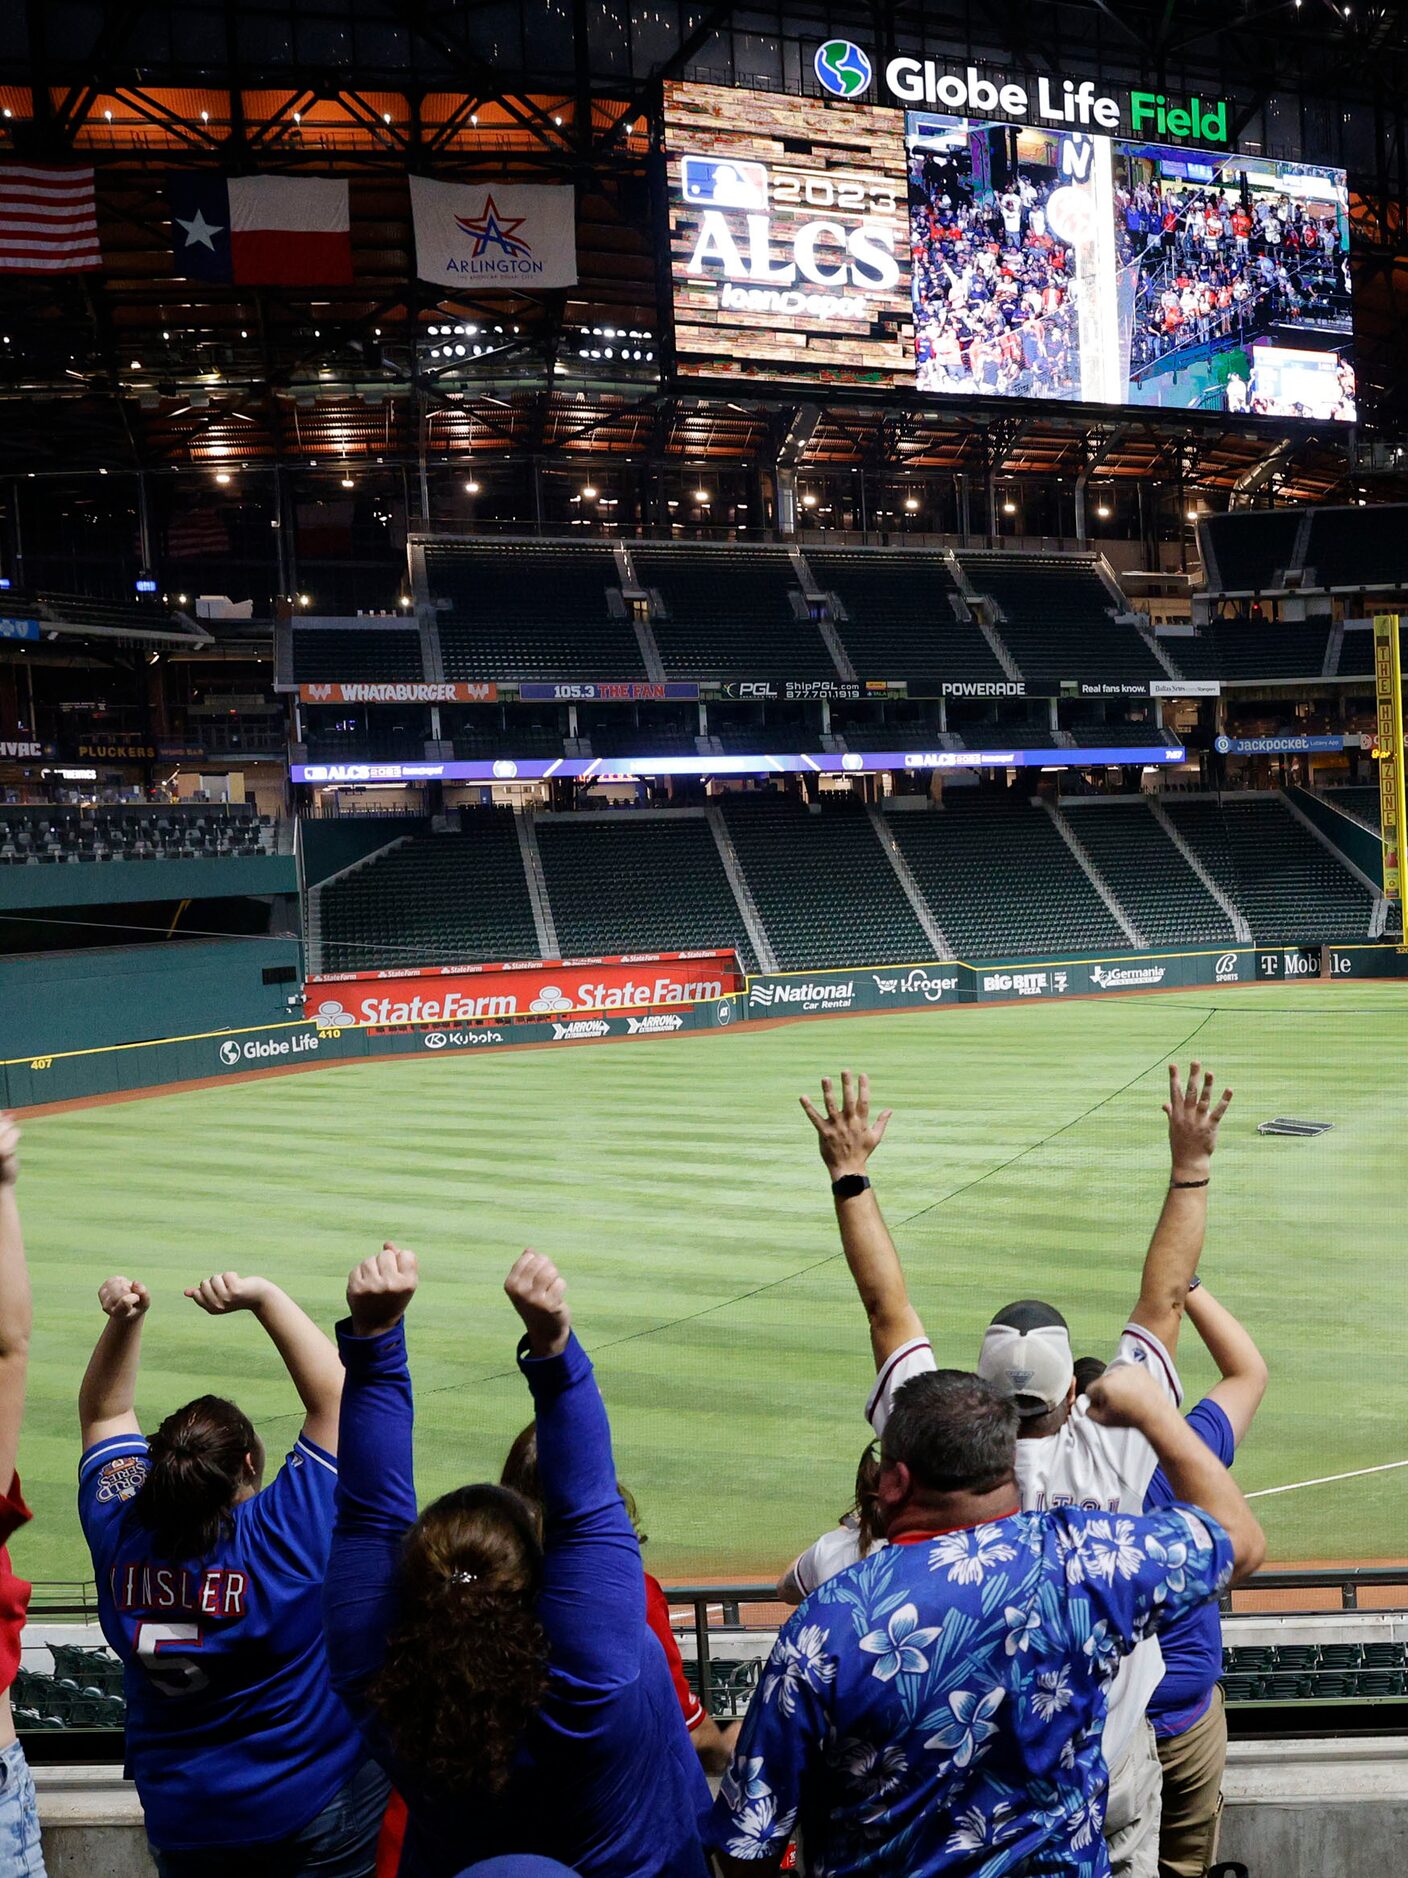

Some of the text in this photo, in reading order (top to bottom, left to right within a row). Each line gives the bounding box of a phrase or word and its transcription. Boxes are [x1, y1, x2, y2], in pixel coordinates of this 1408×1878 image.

[886, 56, 1227, 142] Globe Life Field
[773, 176, 897, 213] 2023
[686, 210, 902, 291] ALCS
[446, 258, 543, 273] ARLINGTON
[340, 684, 458, 701] WHATABURGER
[554, 684, 666, 698] 105.3 THE FAN
[739, 683, 778, 696] PGL
[941, 683, 1026, 696] POWERADE
[1082, 684, 1147, 693] Real fans know.
[79, 746, 155, 758] PLUCKERS
[1111, 966, 1166, 979] Germania
[1215, 973, 1239, 982] SPORTS
[901, 969, 959, 1001] Kroger
[1013, 973, 1049, 989] BITE
[1018, 986, 1042, 995] PIZZA
[803, 999, 852, 1010] Car Rental
[567, 1021, 602, 1032] ARROW
[641, 1016, 676, 1027] ARROW
[319, 1029, 341, 1039] 410
[449, 1031, 504, 1045] Kubota
[243, 1036, 319, 1060] Globe Life
[30, 1058, 53, 1070] 407
[133, 1620, 209, 1697] 5
